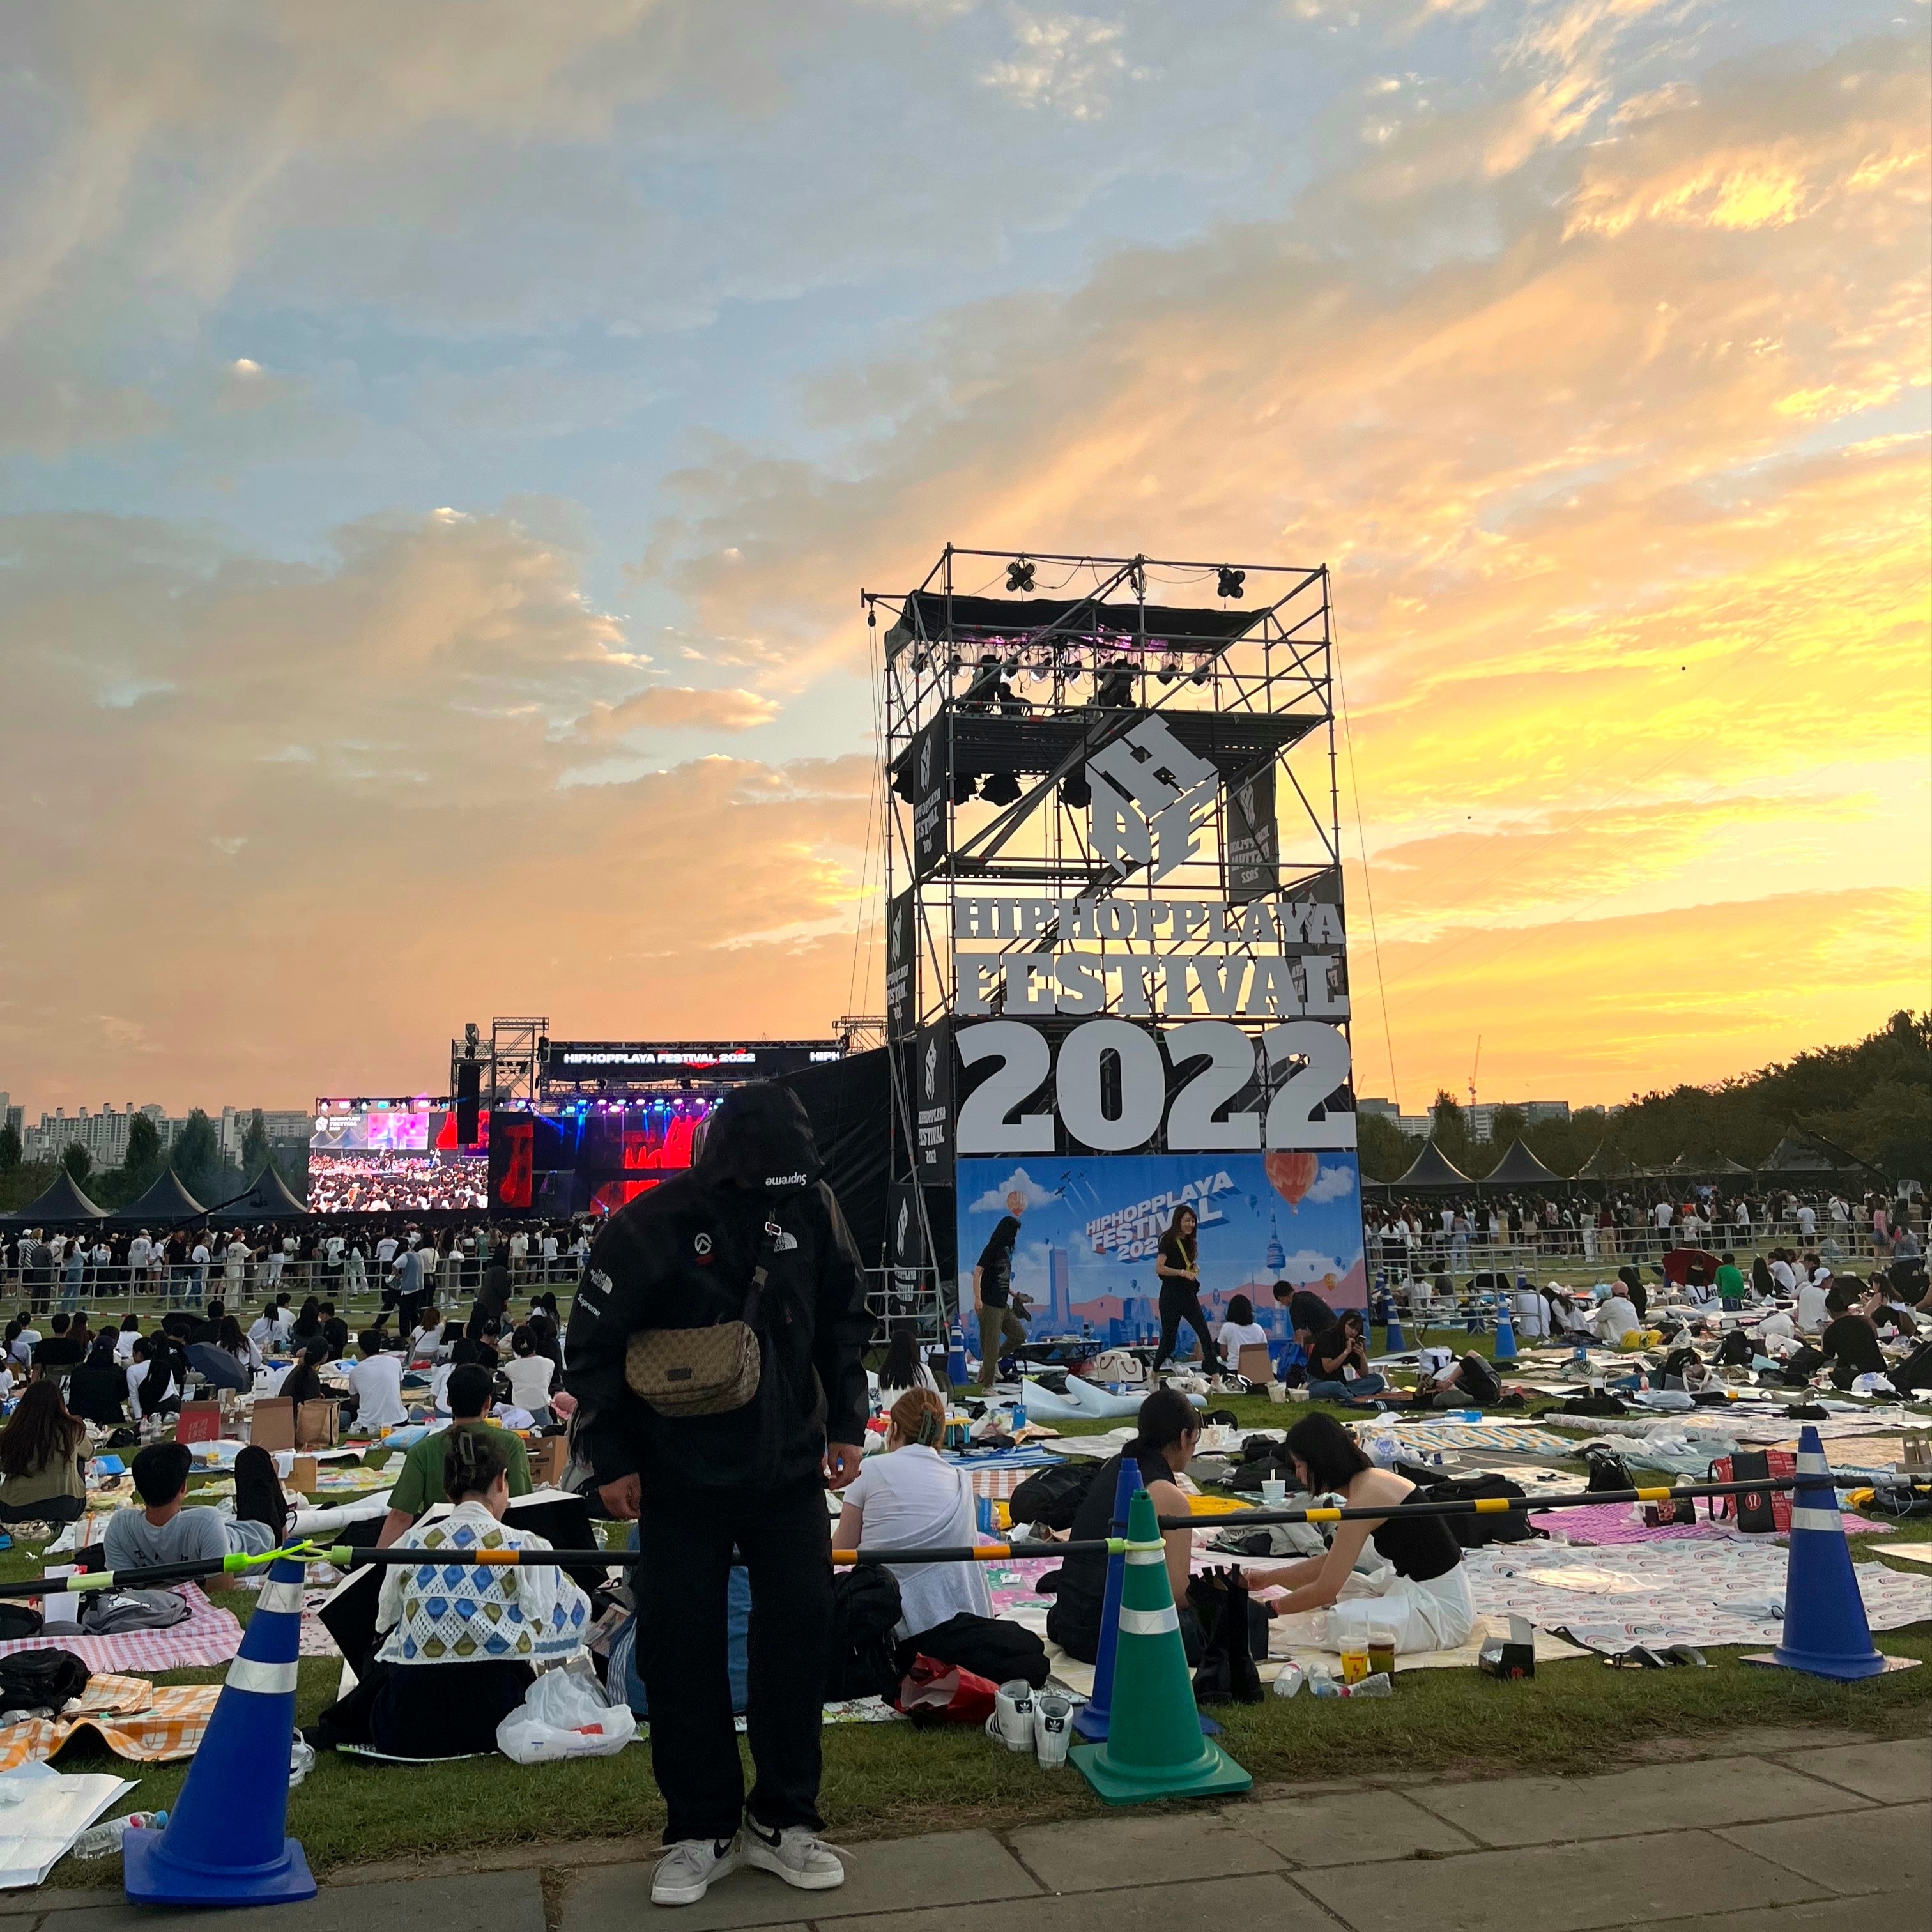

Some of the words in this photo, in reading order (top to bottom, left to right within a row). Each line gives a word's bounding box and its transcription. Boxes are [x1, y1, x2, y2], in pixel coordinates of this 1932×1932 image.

[954, 897, 1347, 944] HIPHOPPLAYA
[954, 951, 1349, 1016] FESTIVAL
[564, 1053, 656, 1064] HIPHOPPLAYA
[657, 1054, 717, 1063] FESTIVAL
[719, 1054, 756, 1062] 2022
[955, 1019, 1358, 1153] 2022
[765, 1172, 807, 1186] Supreme
[1086, 1170, 1234, 1236] HIPHOPPLAYA
[1117, 1237, 1159, 1261] 202
[578, 1293, 601, 1317] Supreme
